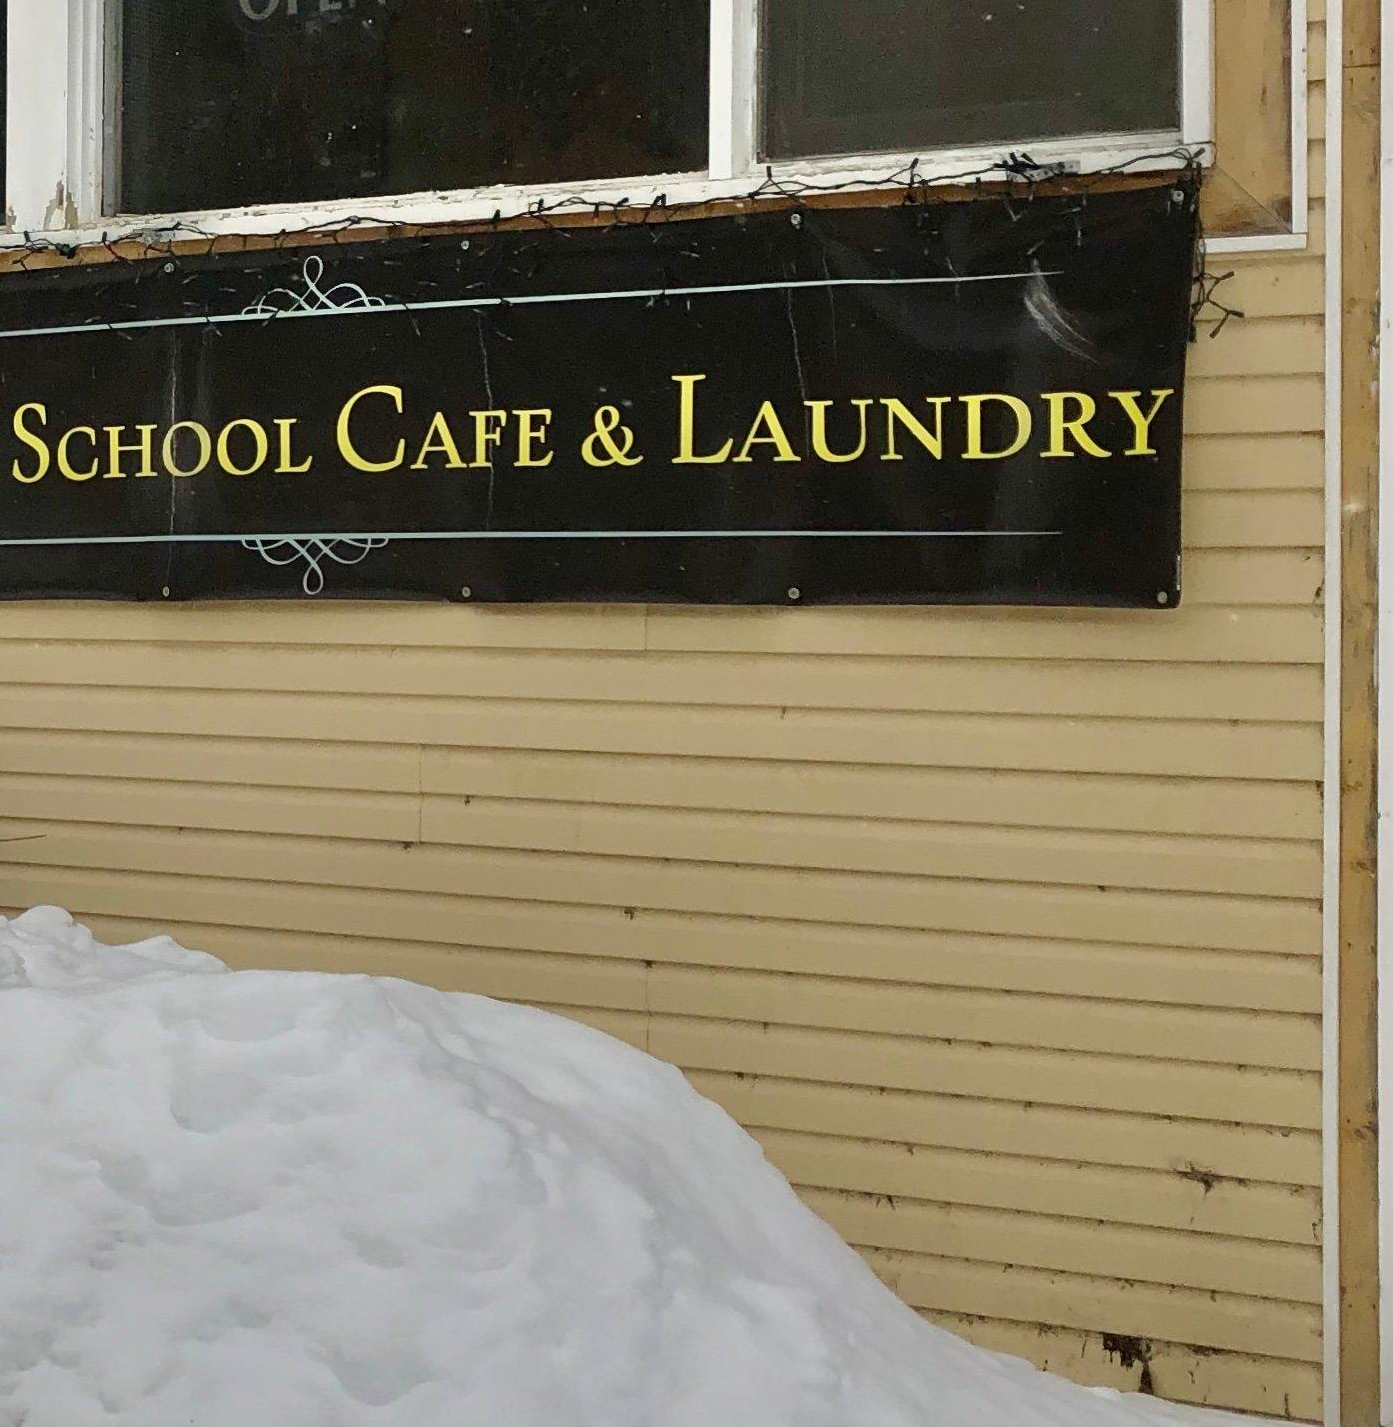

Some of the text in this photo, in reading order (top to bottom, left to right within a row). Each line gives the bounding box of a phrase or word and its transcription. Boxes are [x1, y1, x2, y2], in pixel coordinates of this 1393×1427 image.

[11, 402, 313, 484] SCHOOL
[336, 384, 554, 473] CAFE
[581, 405, 643, 467] &
[671, 373, 1175, 464] LAUNDRY
